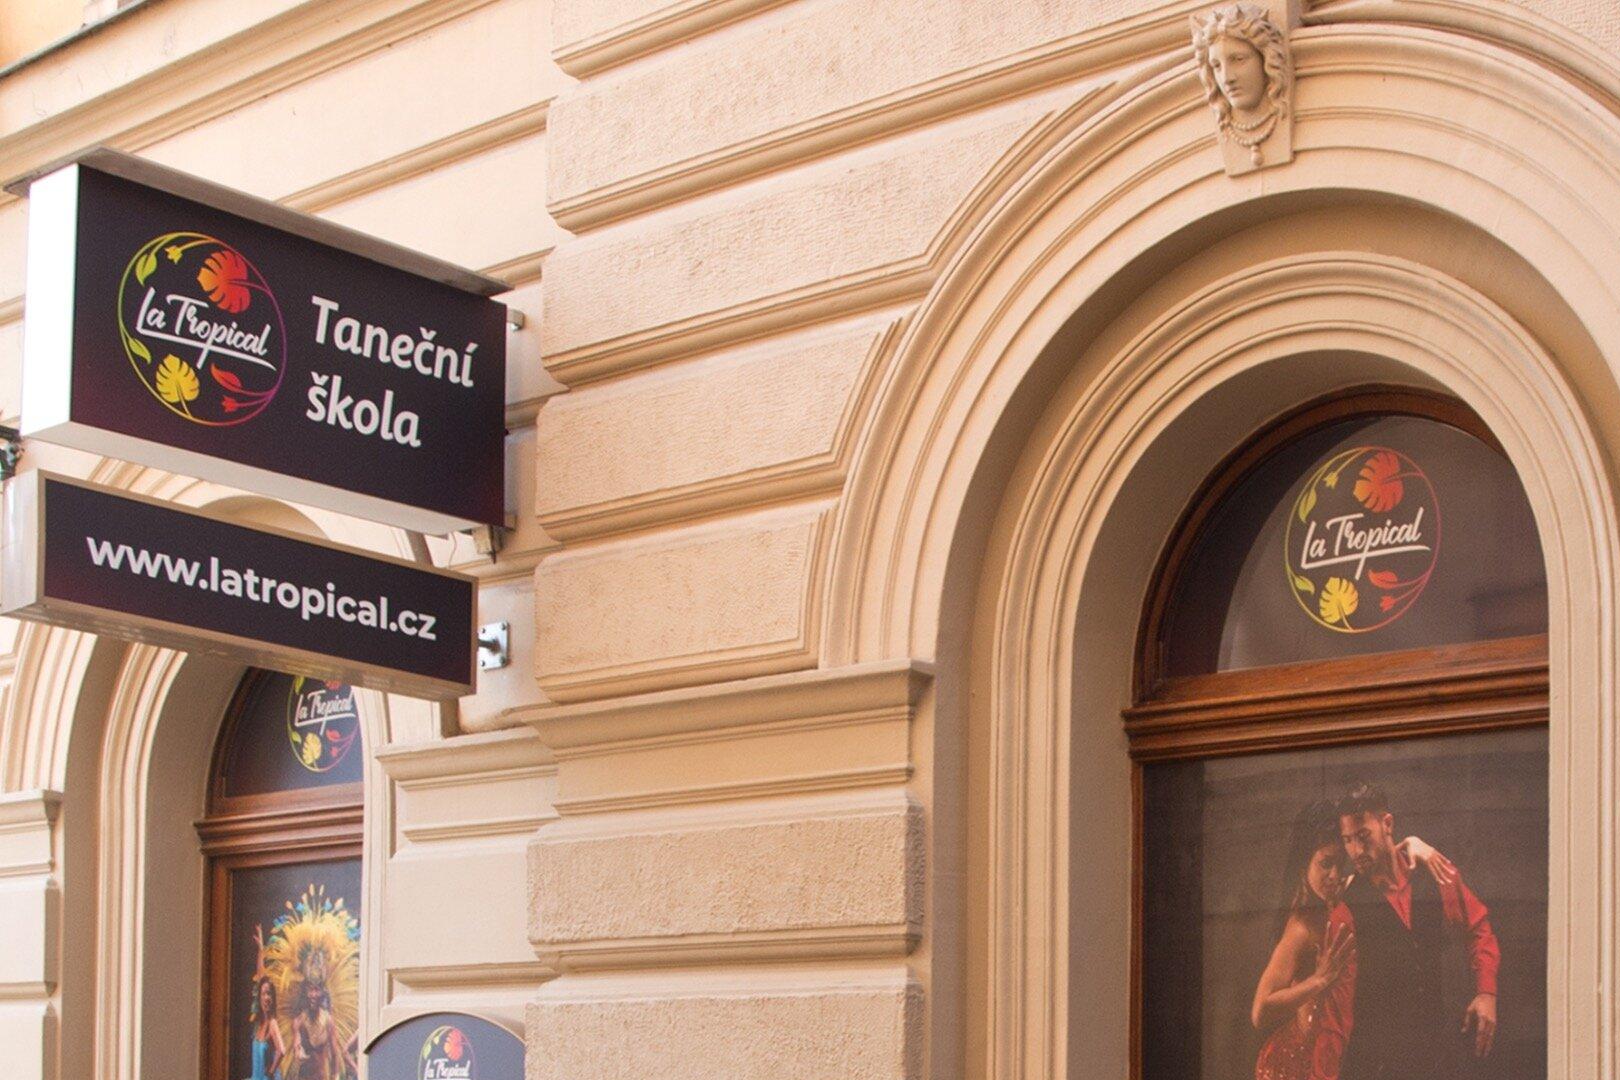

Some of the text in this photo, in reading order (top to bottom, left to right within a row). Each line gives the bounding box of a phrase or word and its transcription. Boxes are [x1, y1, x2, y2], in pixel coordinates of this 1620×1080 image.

[167, 293, 271, 369] Tropical
[312, 295, 480, 388] Taneční
[306, 371, 422, 448] škola
[1326, 506, 1424, 580] Tropical
[86, 536, 437, 642] www.latropical.cz
[307, 688, 354, 736] Tropical
